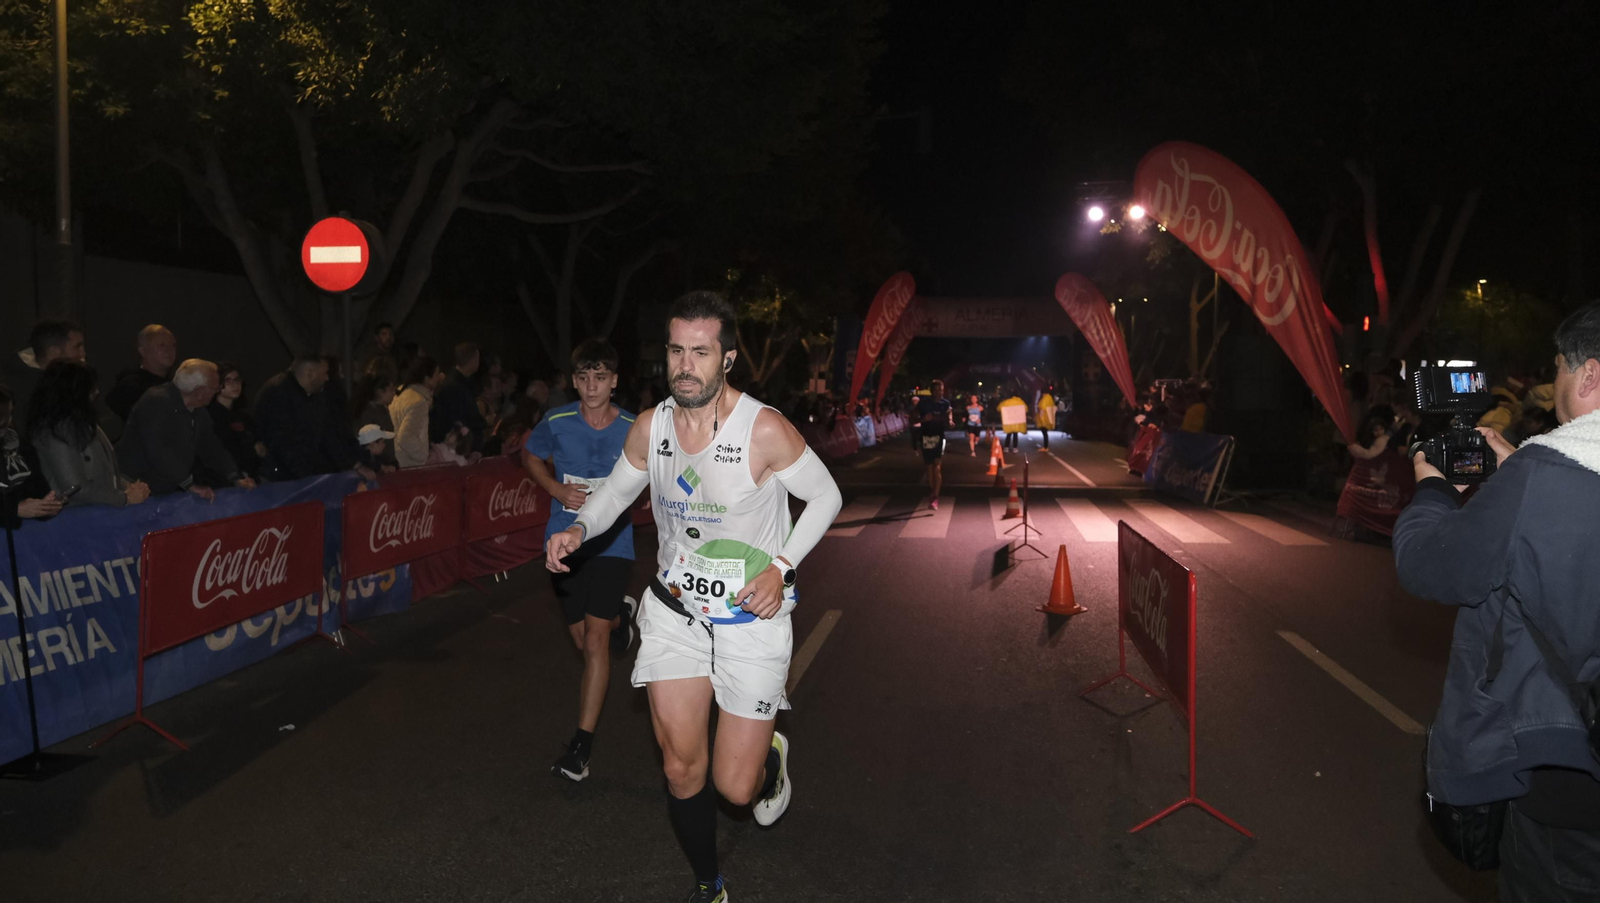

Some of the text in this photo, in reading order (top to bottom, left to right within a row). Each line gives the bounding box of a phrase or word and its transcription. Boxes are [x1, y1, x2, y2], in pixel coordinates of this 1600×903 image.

[865, 276, 912, 358] Coca-Cola
[370, 493, 437, 553] Coca-Cola
[488, 478, 538, 521] Coca-Cola
[658, 494, 728, 514] Murgiverde
[192, 525, 293, 609] Coca-Cola
[682, 572, 725, 597] 360
[1129, 551, 1168, 659] Coca-Cola
